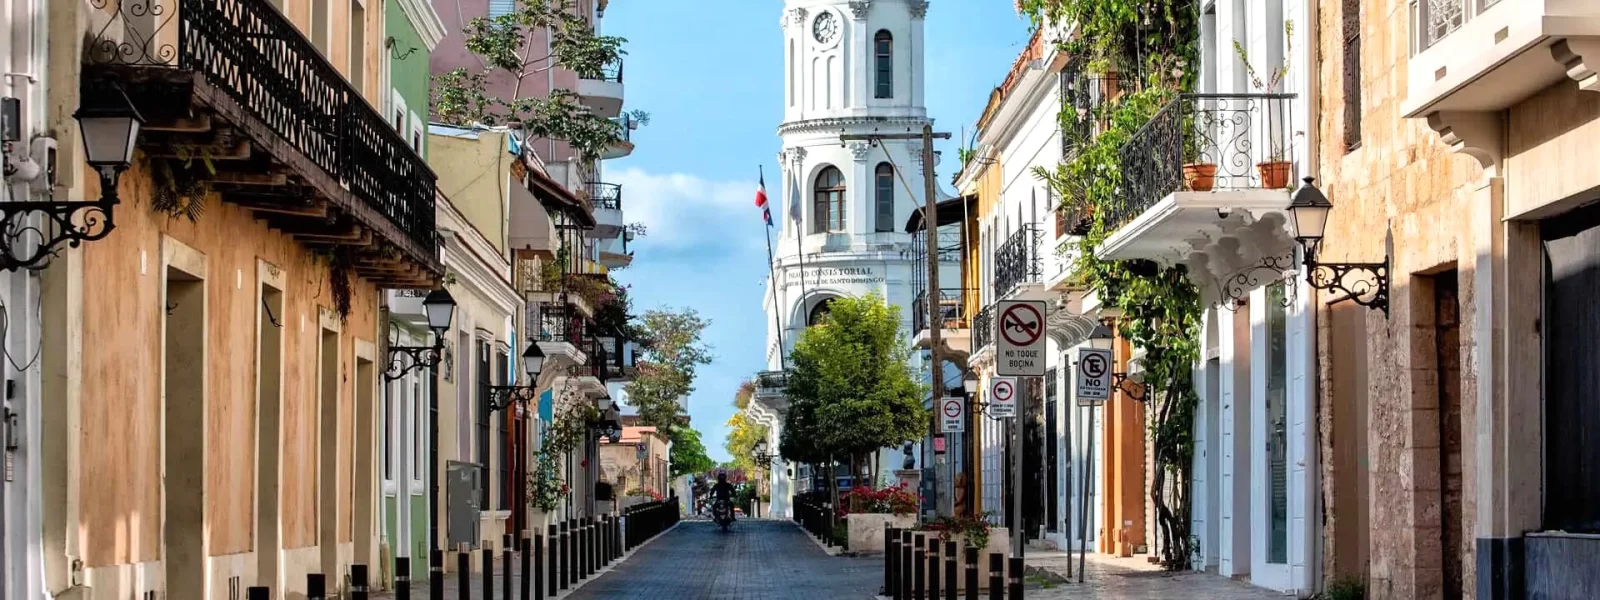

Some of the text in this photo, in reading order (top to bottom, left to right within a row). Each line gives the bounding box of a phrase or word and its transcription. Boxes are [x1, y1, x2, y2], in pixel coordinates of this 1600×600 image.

[789, 267, 873, 279] PALACO CONSISTORIAL
[1005, 350, 1039, 358] NO TOQUE
[1085, 379, 1101, 387] NO
